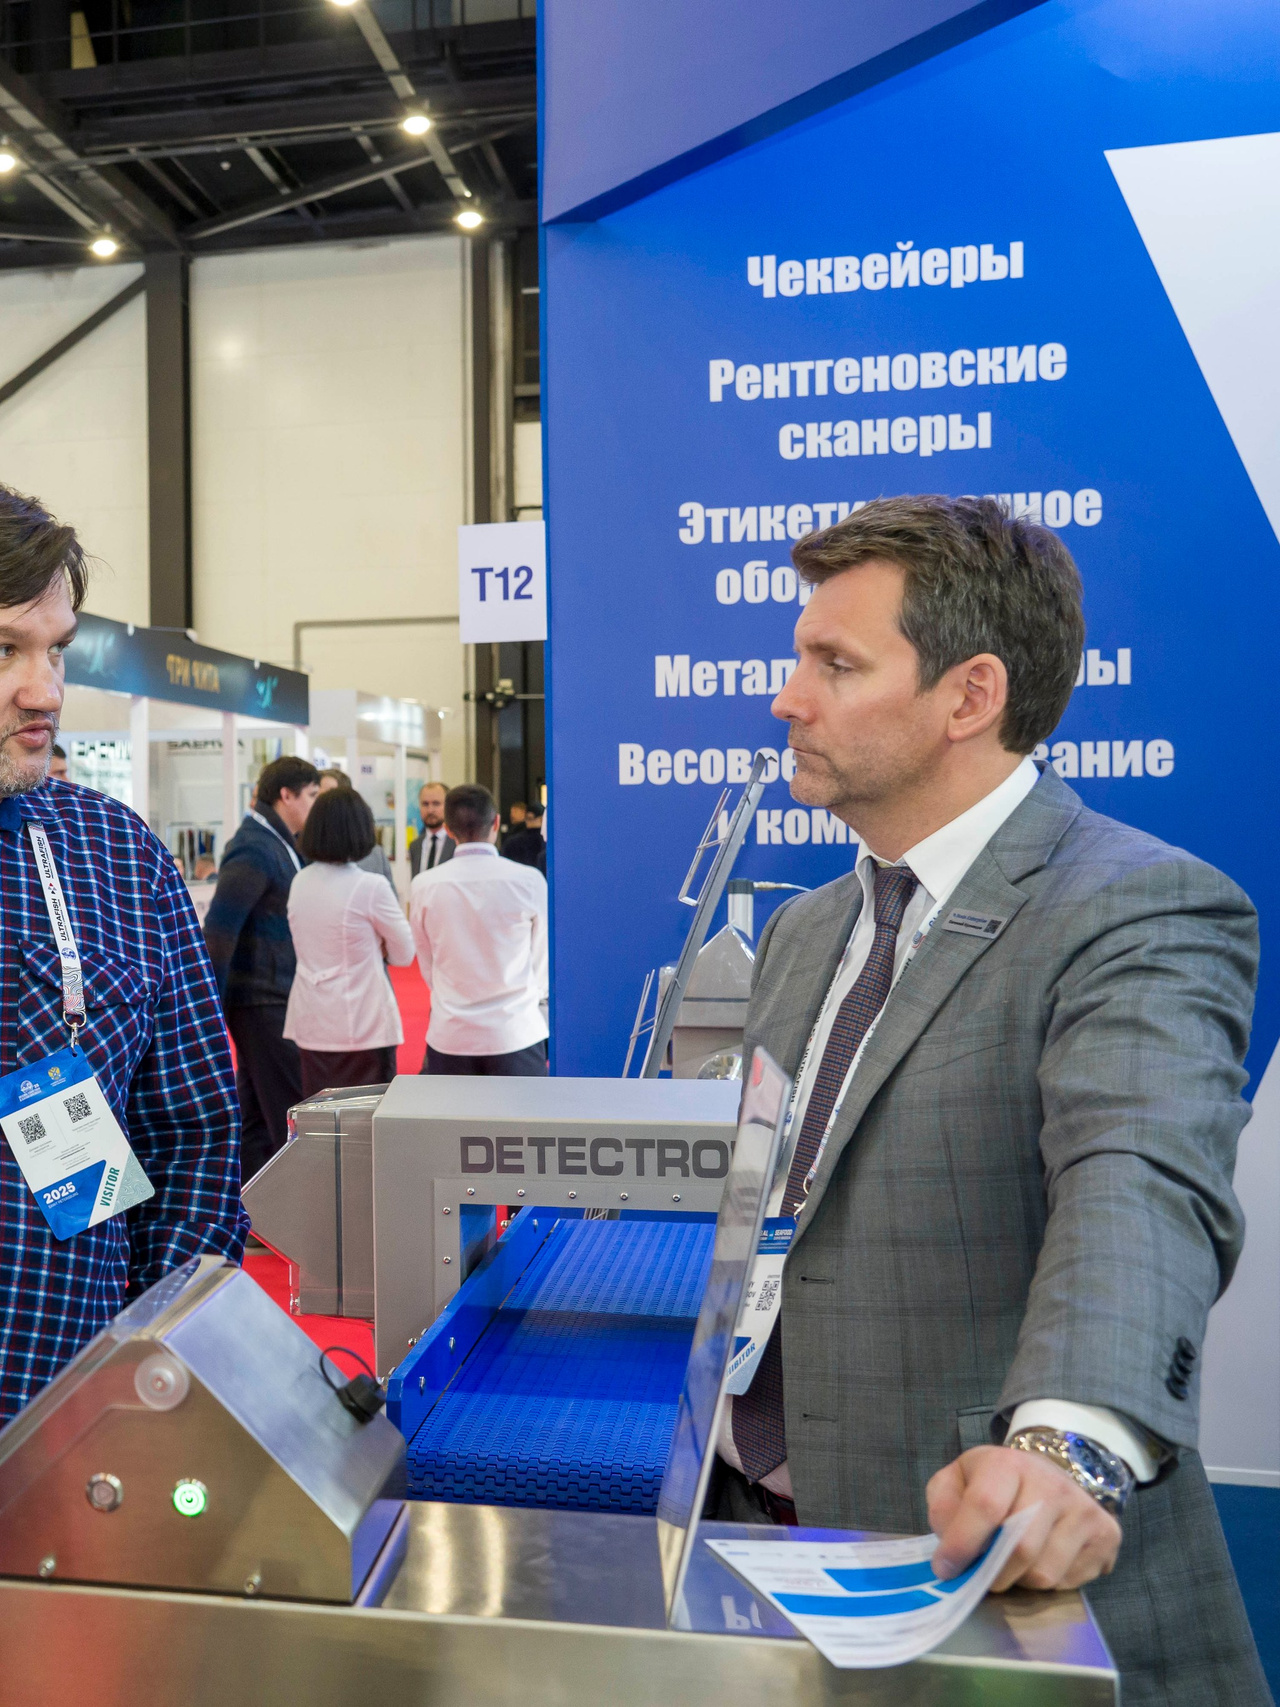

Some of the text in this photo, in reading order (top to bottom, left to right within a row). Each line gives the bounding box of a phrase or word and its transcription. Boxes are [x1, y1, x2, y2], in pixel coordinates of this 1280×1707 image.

[746, 240, 1025, 298] Чеквейеры
[708, 342, 1068, 402] Рентгеновские
[778, 411, 992, 460] сканеры
[470, 565, 534, 602] T12
[36, 836, 51, 879] ULTRAFISH
[52, 898, 67, 941] ULTRAFISH
[790, 1047, 810, 1103] ULTRAFISH
[42, 1181, 76, 1205] 2025
[99, 1166, 120, 1207] VISITOR
